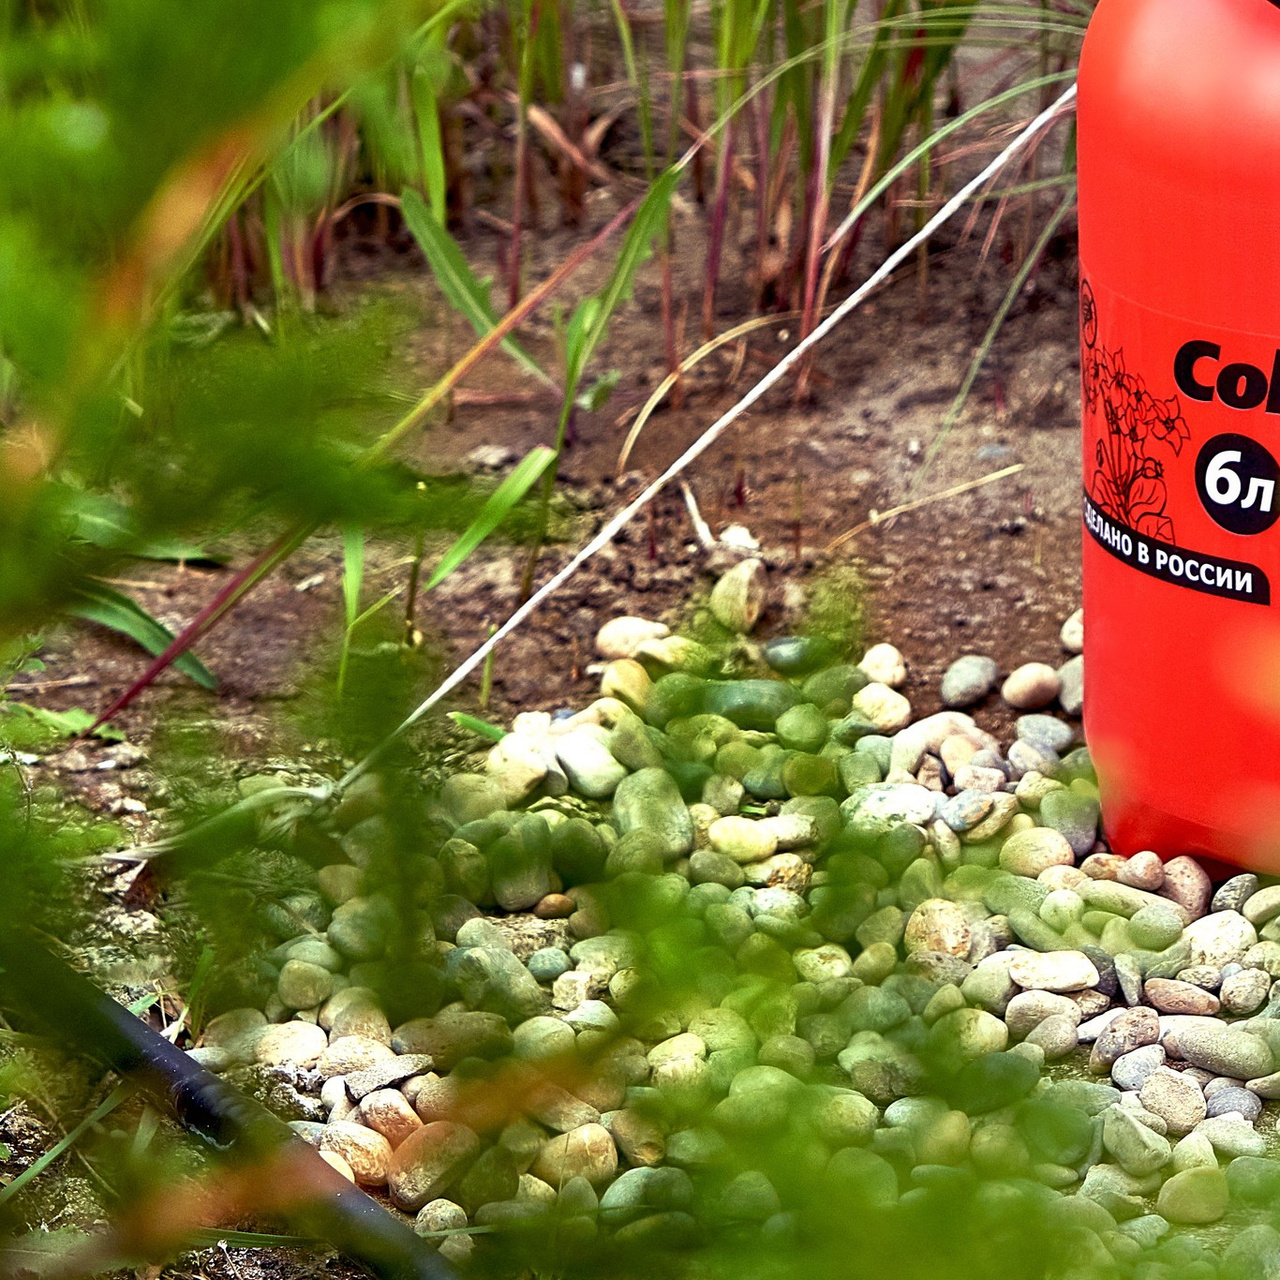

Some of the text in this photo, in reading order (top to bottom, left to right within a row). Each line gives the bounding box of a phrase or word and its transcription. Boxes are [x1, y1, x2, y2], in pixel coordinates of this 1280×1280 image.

[1204, 450, 1276, 513] 6л
[1137, 541, 1150, 565] В
[1155, 548, 1253, 594] РОССИИ
